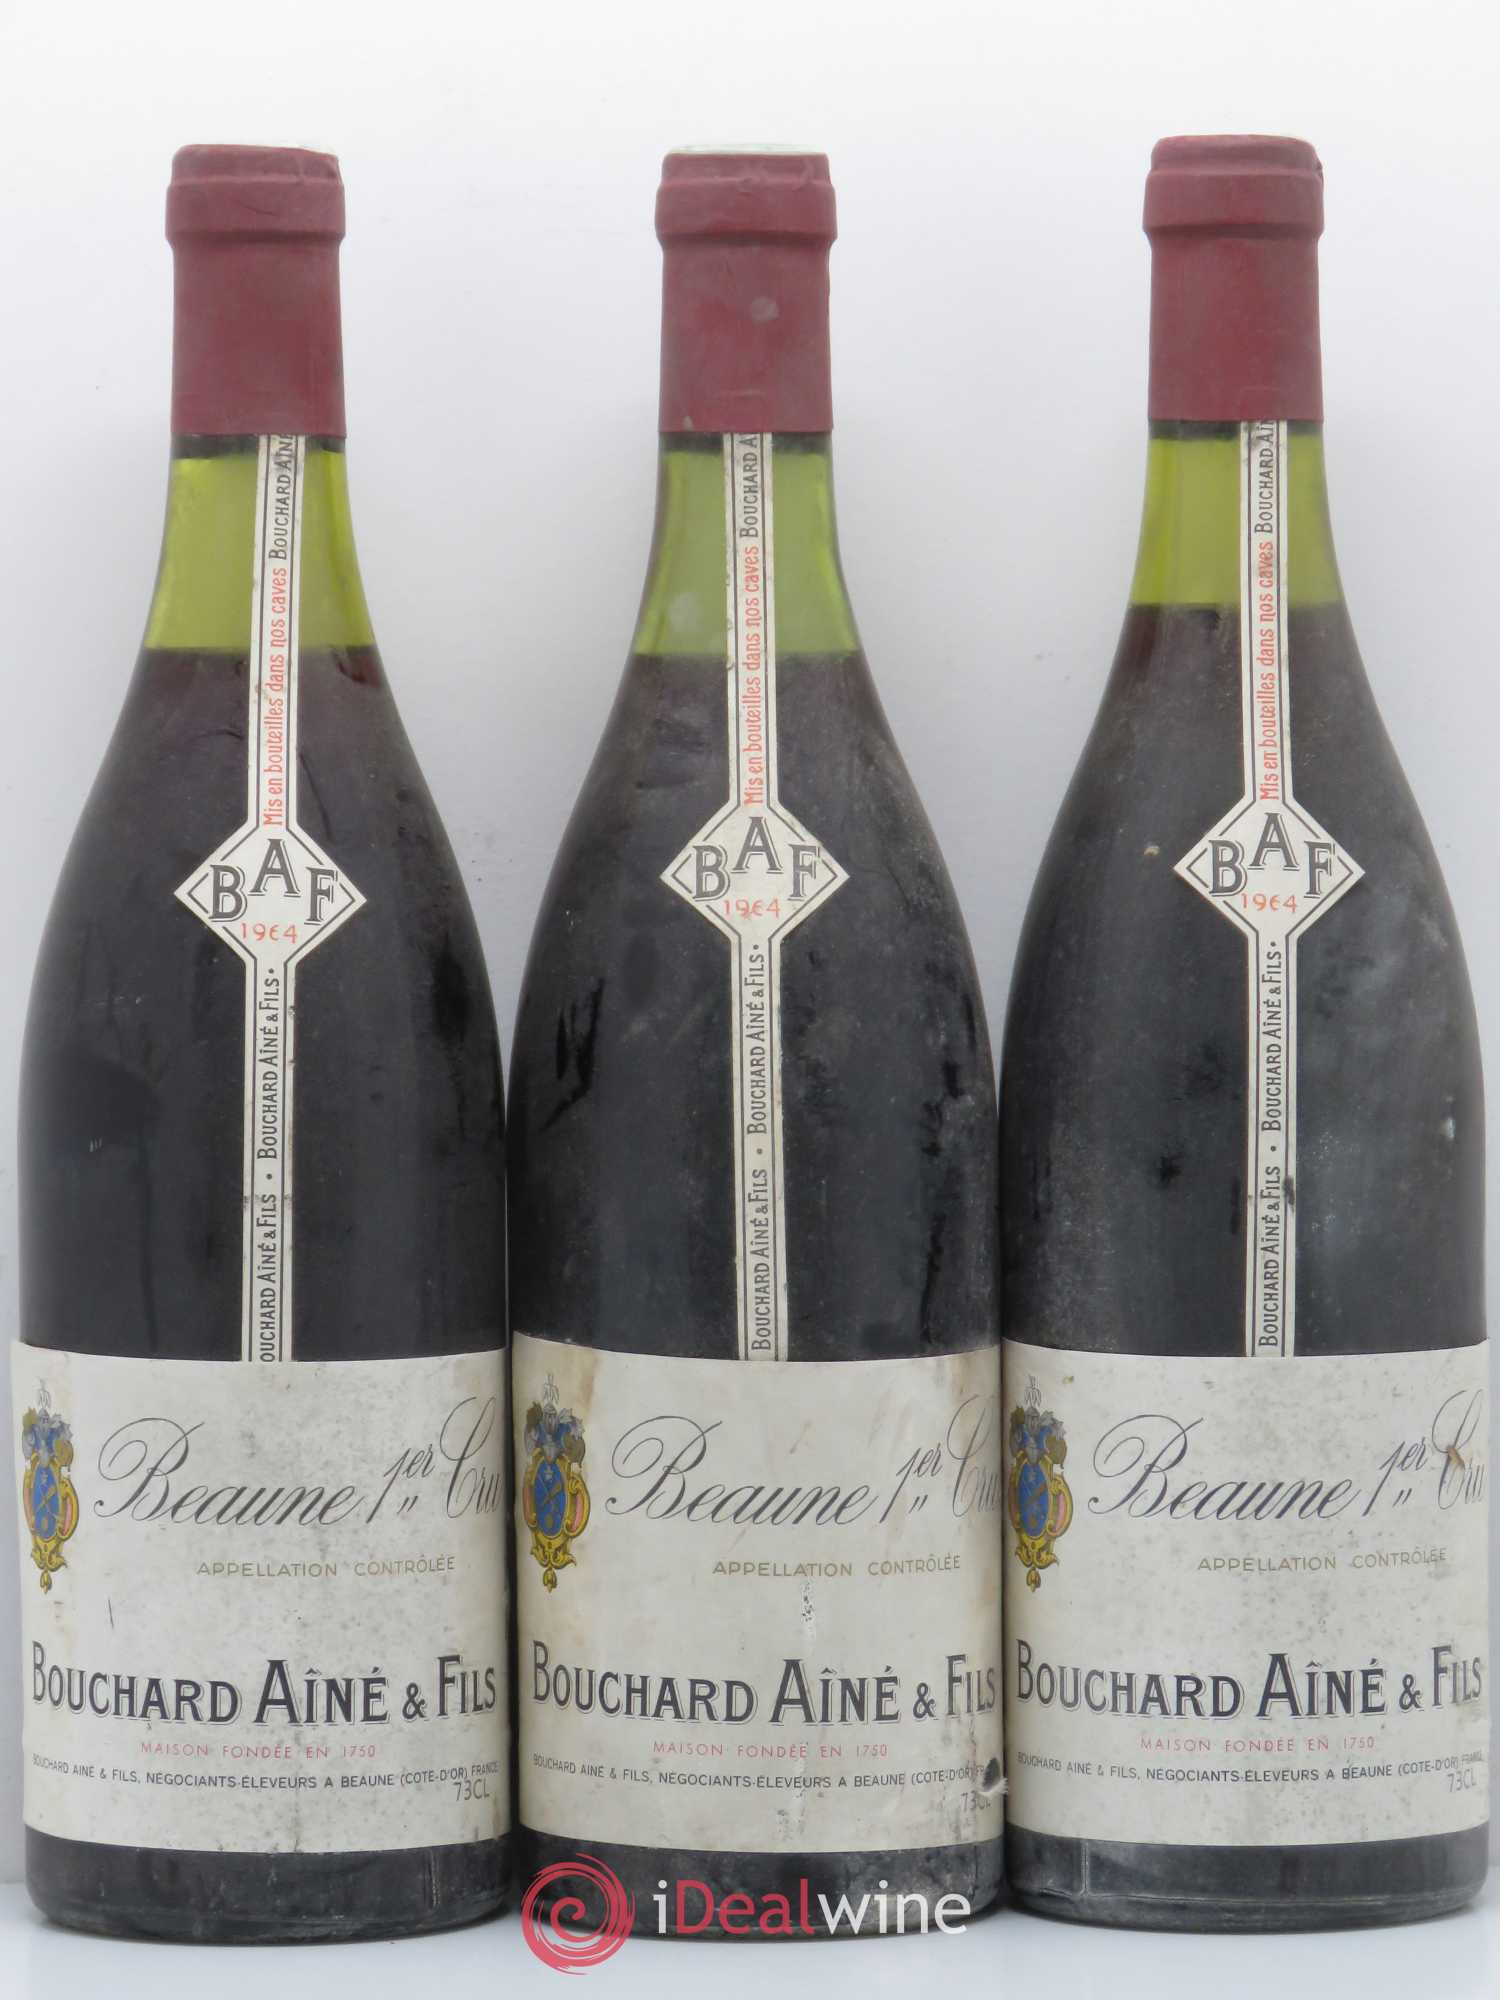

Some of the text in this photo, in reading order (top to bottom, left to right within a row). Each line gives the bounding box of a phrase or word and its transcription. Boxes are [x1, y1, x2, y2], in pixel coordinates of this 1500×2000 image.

[739, 453, 759, 538] BOUCHARD
[1254, 448, 1275, 534] BOUCHARD
[268, 475, 292, 560] BOUCHARD
[744, 545, 759, 593] caves
[1259, 541, 1274, 588] caves
[271, 567, 288, 614] caves
[745, 598, 762, 627] nos
[1260, 594, 1276, 622] nos
[270, 619, 286, 648] nos
[1256, 629, 1275, 667] dans
[742, 633, 762, 671] dans
[266, 655, 285, 692] dans
[742, 676, 762, 753] bouteilles
[1256, 672, 1278, 749] bouteilles
[264, 698, 284, 774] bouteilles
[748, 756, 763, 774] en
[1263, 752, 1279, 770] en
[268, 777, 283, 795] en
[744, 776, 763, 806] Mis
[1260, 773, 1279, 801] Mis
[263, 798, 282, 827] Mis
[744, 953, 765, 987] FILS
[1261, 951, 1282, 983] FILS
[259, 978, 280, 1011] FILS
[751, 989, 764, 998] &
[1269, 986, 1281, 995] &
[265, 1014, 279, 1022] &
[747, 1046, 767, 1134] BOUCHARD
[1261, 1043, 1282, 1132] BOUCHARD
[257, 1071, 278, 1159] BOUCHARD
[748, 1169, 768, 1203] FILS
[1260, 1166, 1280, 1200] FILS
[256, 1194, 277, 1227] FILS
[755, 1204, 769, 1214] &
[1267, 1201, 1280, 1210] &
[263, 1230, 277, 1239] &
[751, 1262, 771, 1350] BOUCHARD
[1258, 1259, 1279, 1347] BOUCHARD
[259, 1287, 276, 1362] OUCHARD
[94, 1418, 363, 1525] Beaune
[439, 1396, 501, 1518] Cru
[605, 1416, 877, 1525] Beaune
[1087, 1414, 1364, 1521] Beaune
[197, 1560, 337, 1577] APPELLATION
[713, 1559, 852, 1577] APPELLATION
[1198, 1555, 1337, 1572] APPELLATION
[32, 1640, 497, 1727] BOUCHARD AÎNÉ & FILS
[533, 1640, 995, 1726] BOUCHARD AÎNÉ & FILS
[1016, 1639, 1482, 1720] BOUCHARD AÎNÉ & FILS
[141, 1742, 209, 1756] MAISON
[306, 1746, 328, 1759] EN
[343, 1745, 376, 1758] 1750
[653, 1741, 723, 1756] MAISON
[821, 1745, 842, 1758] EN
[856, 1744, 888, 1757] 1750
[1141, 1737, 1210, 1752] MAISON
[1307, 1738, 1329, 1751] EN
[1343, 1736, 1376, 1749] 1750
[324, 1778, 333, 1788] A
[341, 1774, 395, 1788] BEAUNE
[838, 1777, 847, 1787] A
[854, 1774, 905, 1788] BEAUNE
[1326, 1769, 1335, 1780] A
[1341, 1764, 1392, 1780] BEAUNE
[1447, 1768, 1478, 1793] 73CL
[454, 1779, 490, 1801] 73CL
